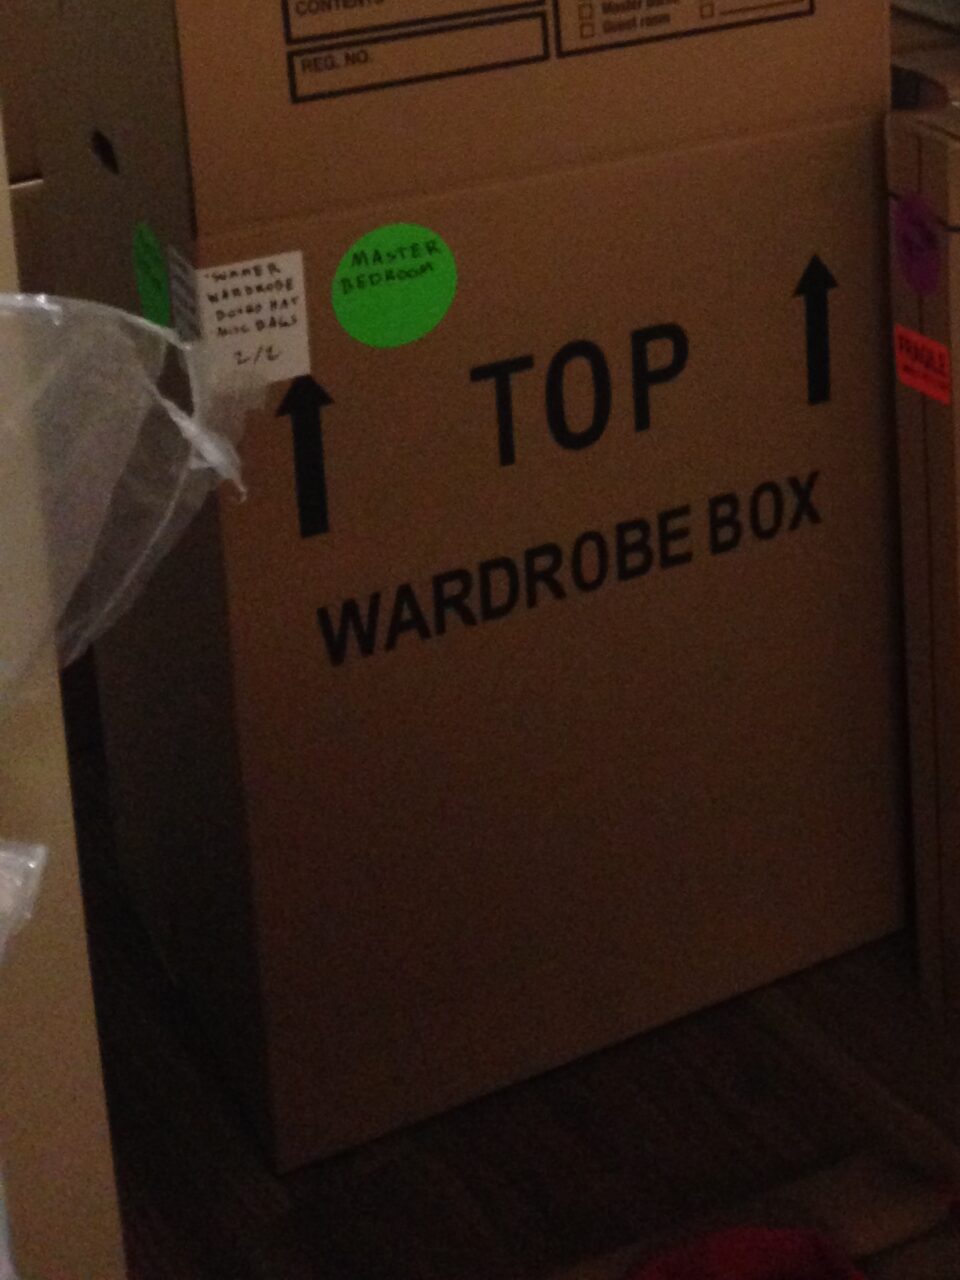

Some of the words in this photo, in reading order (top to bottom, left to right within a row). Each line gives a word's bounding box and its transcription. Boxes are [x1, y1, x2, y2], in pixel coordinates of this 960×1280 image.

[340, 261, 435, 296] BEDROOM
[350, 239, 442, 268] MASTER
[469, 322, 690, 467] TOP
[316, 504, 695, 667] WARDROBE
[707, 470, 823, 556] BOX
